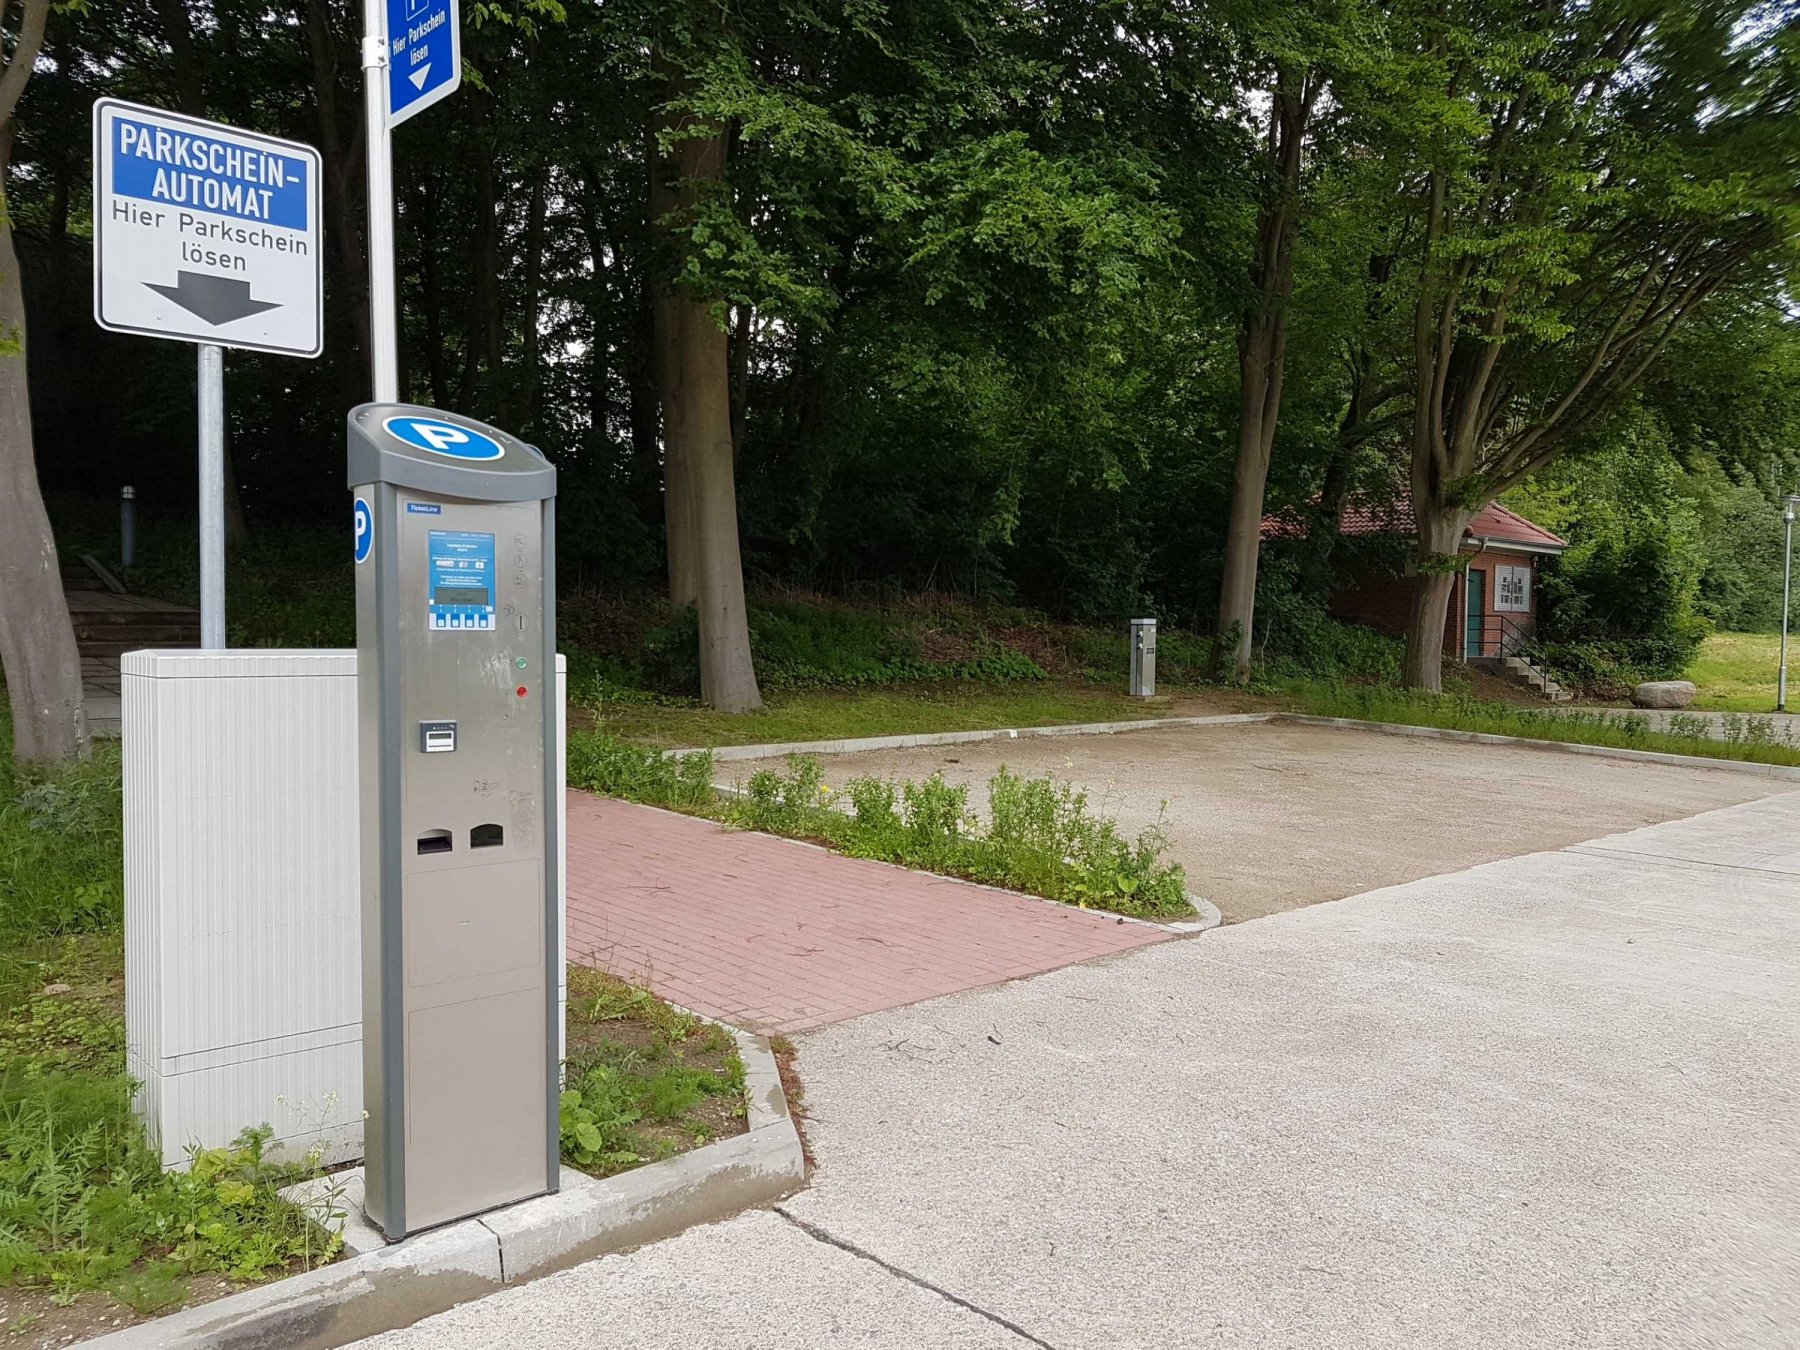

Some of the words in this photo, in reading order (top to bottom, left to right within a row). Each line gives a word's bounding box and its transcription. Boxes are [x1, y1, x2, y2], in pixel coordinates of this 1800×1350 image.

[392, 36, 406, 56] Hier
[408, 8, 446, 45] Parkschein
[410, 44, 429, 66] lösen
[120, 122, 300, 188] PARKSCHEIN-
[151, 167, 274, 219] AUTOMAT
[112, 200, 166, 228] Hier
[179, 212, 308, 255] Parkschein
[182, 241, 247, 271] lösen
[410, 423, 470, 450] P
[355, 510, 367, 550] P
